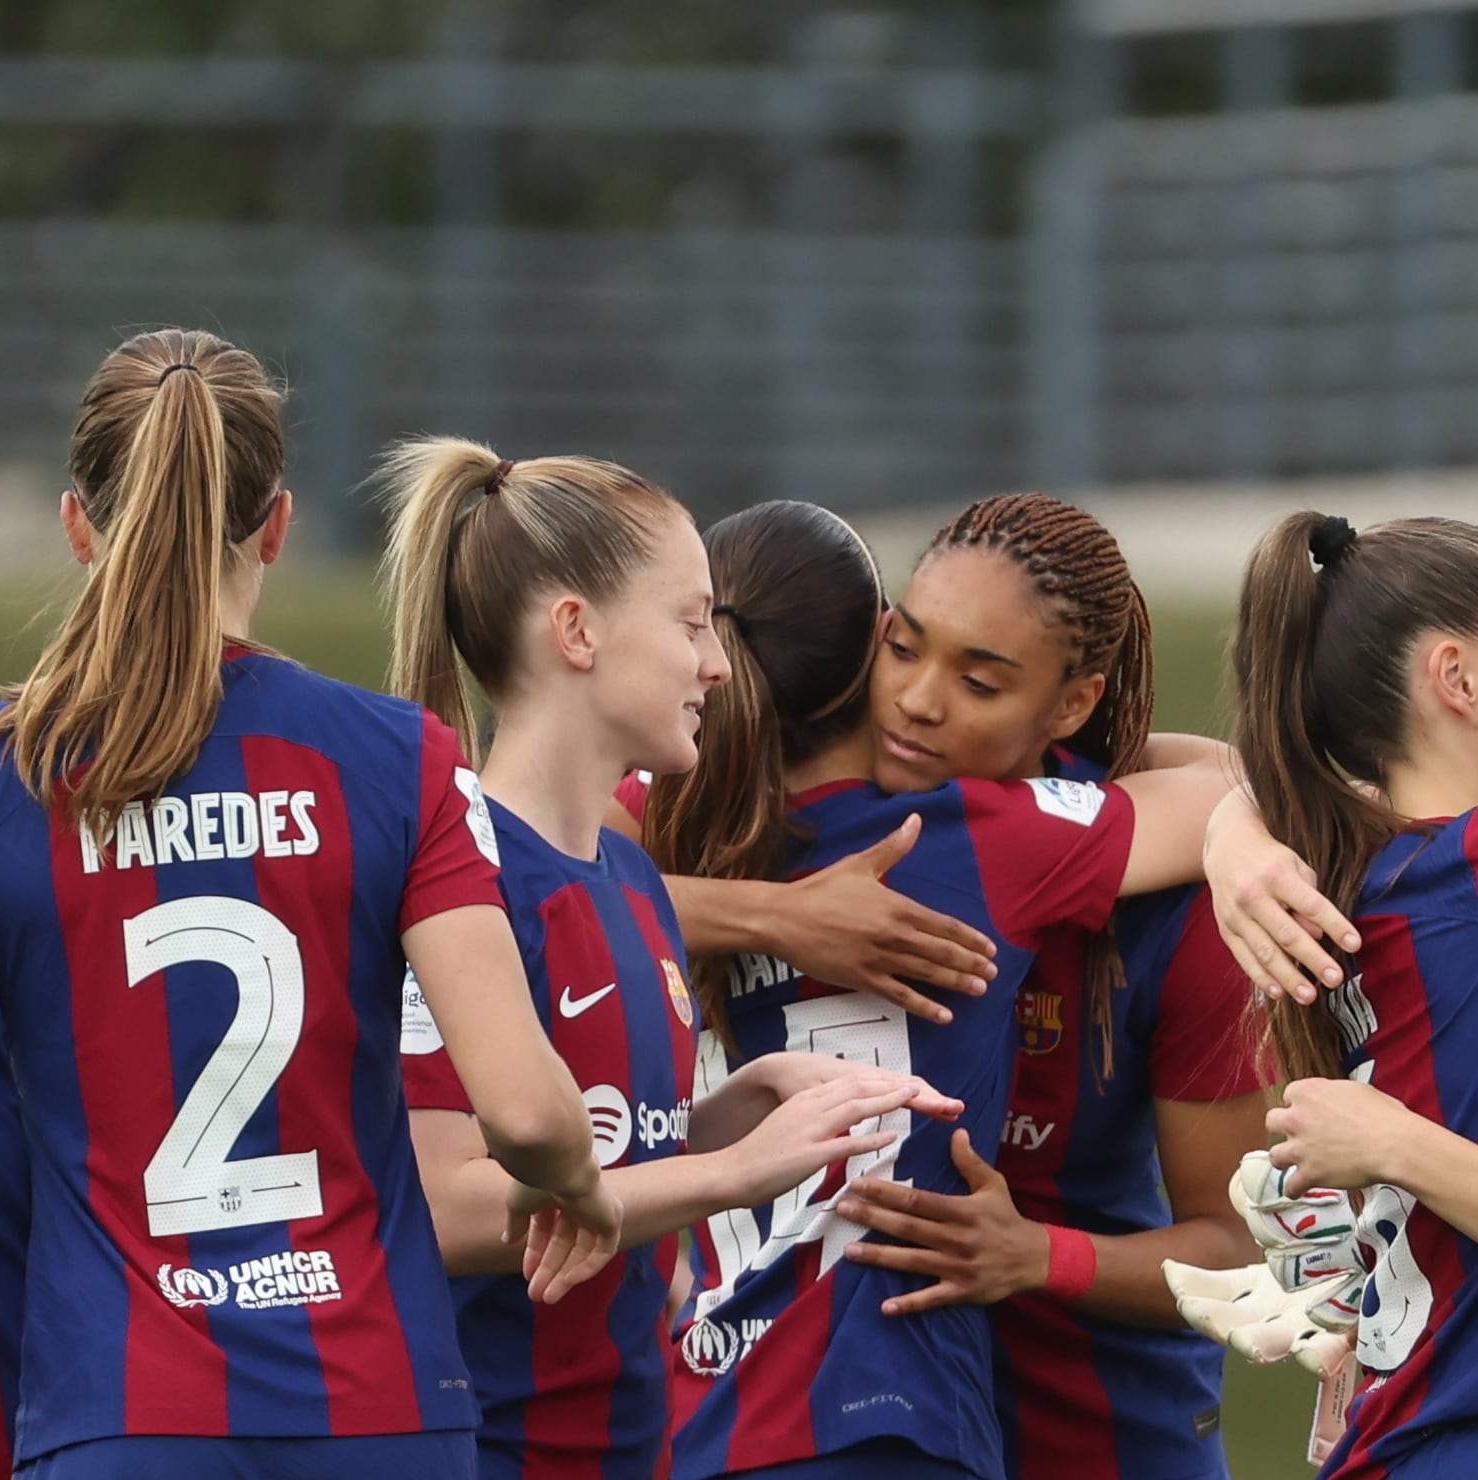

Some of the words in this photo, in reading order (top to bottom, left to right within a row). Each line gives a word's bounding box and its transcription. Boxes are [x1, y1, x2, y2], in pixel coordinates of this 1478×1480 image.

[78, 790, 320, 874] PAREDES
[123, 895, 323, 1237] 2
[229, 1250, 334, 1284] UNHCR
[235, 1271, 340, 1303] ACNUR
[257, 1299, 271, 1309] UN
